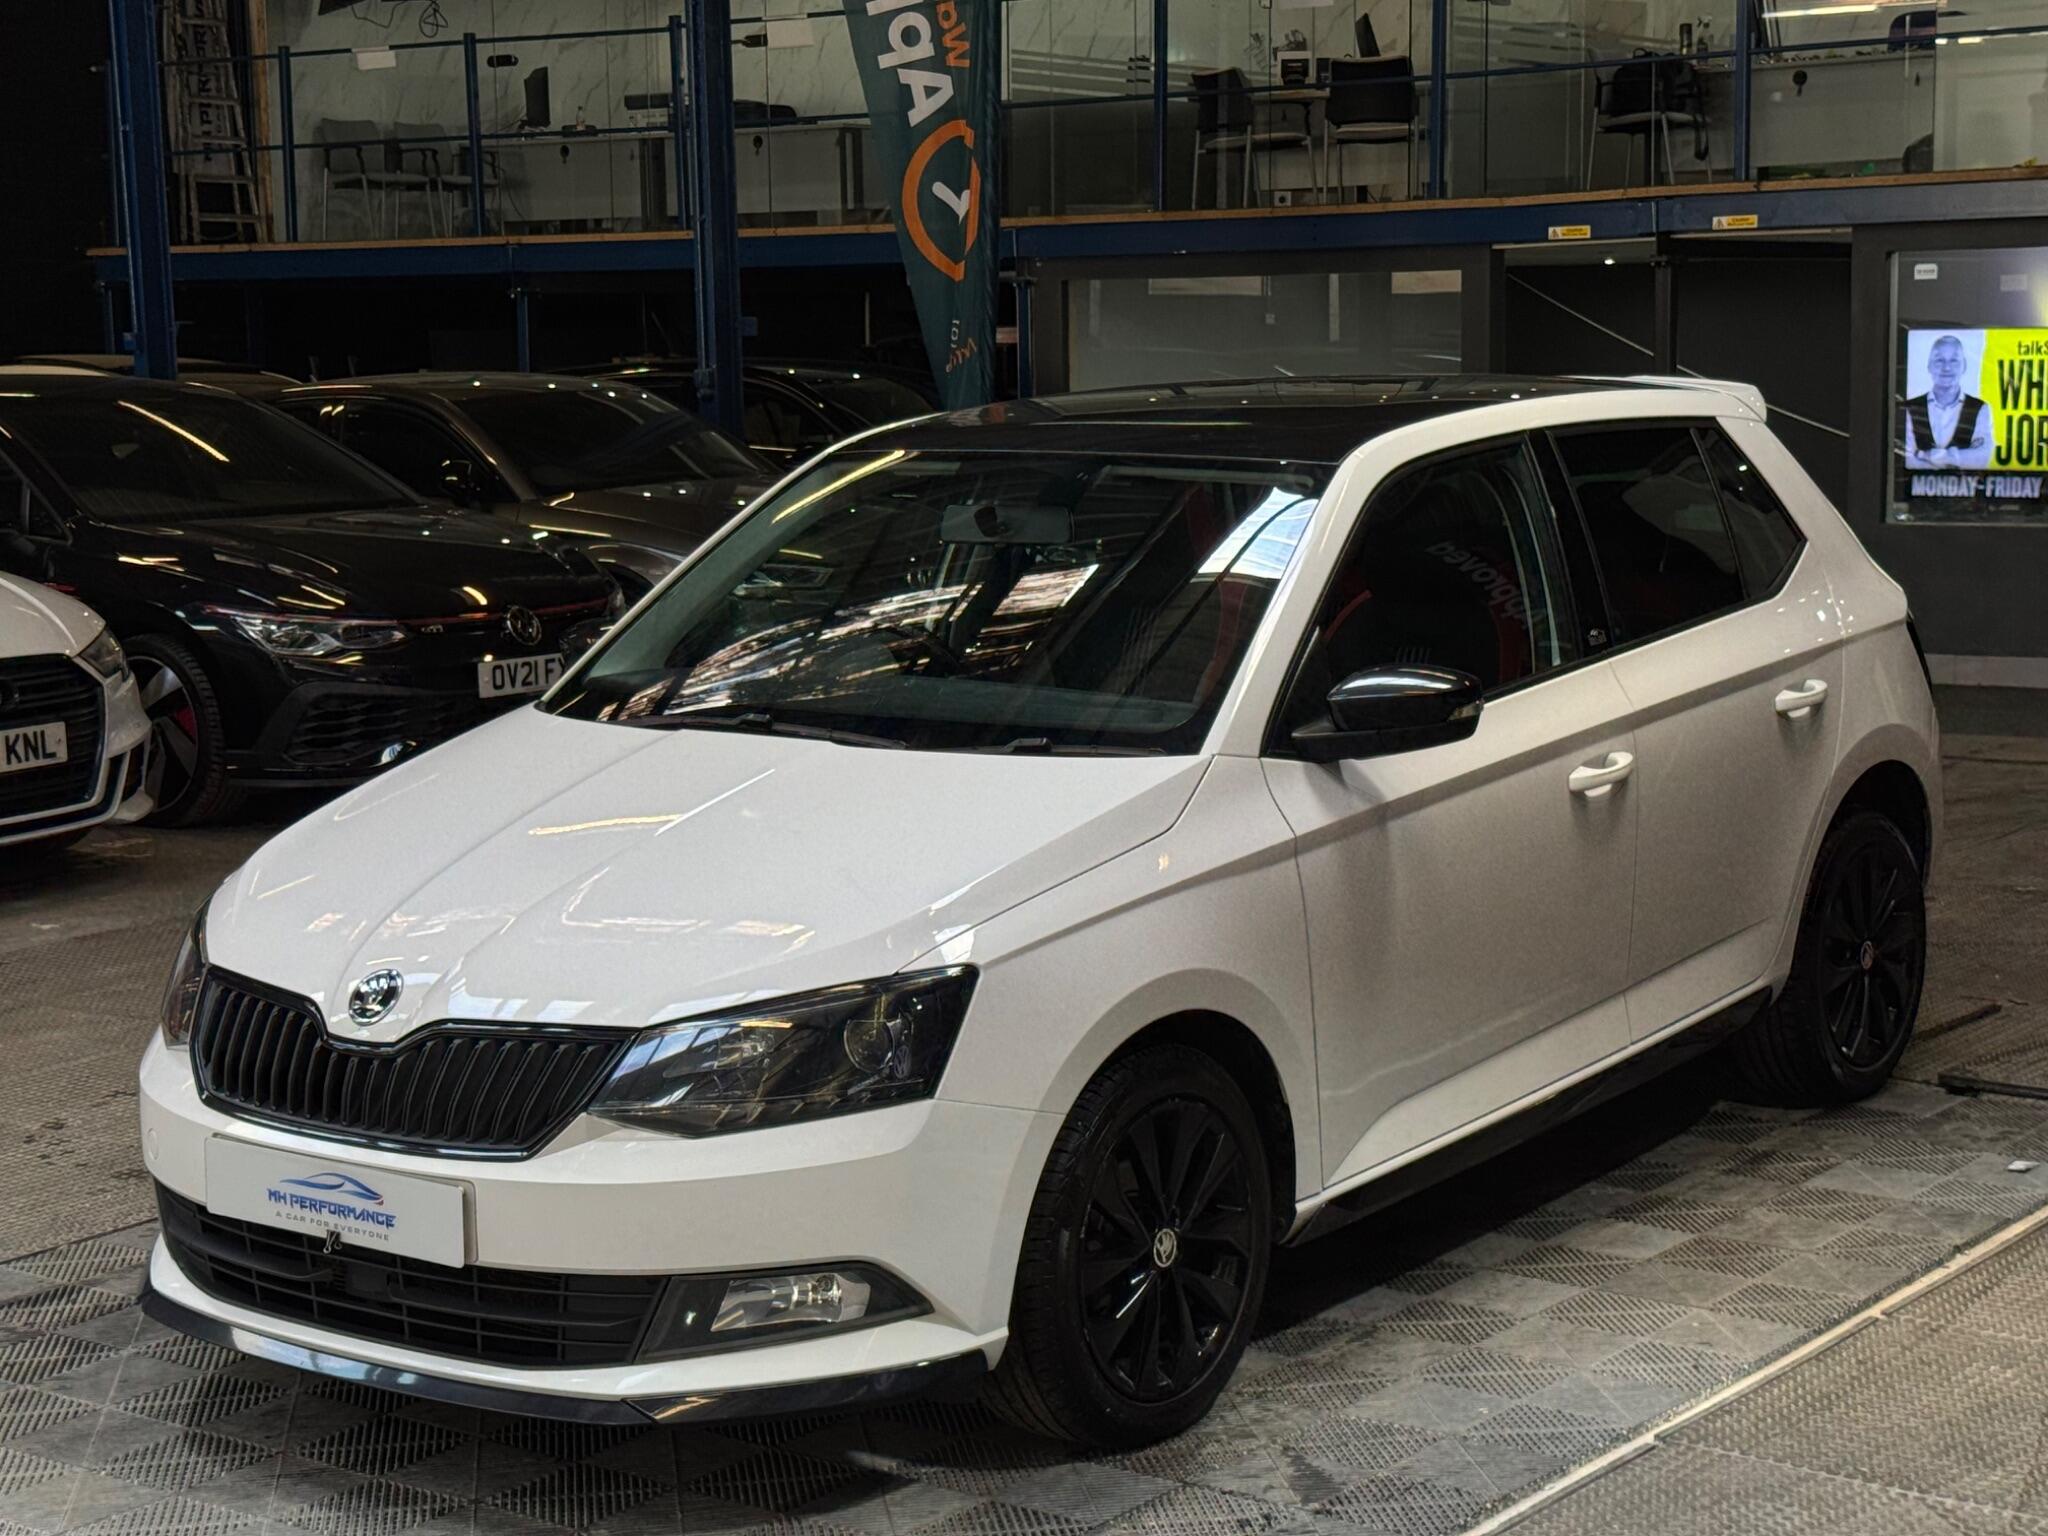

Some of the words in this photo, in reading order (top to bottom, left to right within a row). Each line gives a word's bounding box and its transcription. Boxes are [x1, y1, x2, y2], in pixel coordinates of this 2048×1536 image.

[1911, 474, 2043, 498] MONDAY-FRIDAY
[492, 660, 539, 690] OV21
[5, 729, 57, 765] KNL
[267, 1188, 287, 1206] MH
[288, 1193, 397, 1230] PERFORMANCE
[286, 1212, 306, 1223] CAR
[310, 1218, 330, 1228] FOR
[333, 1223, 389, 1241] EVERYONE
